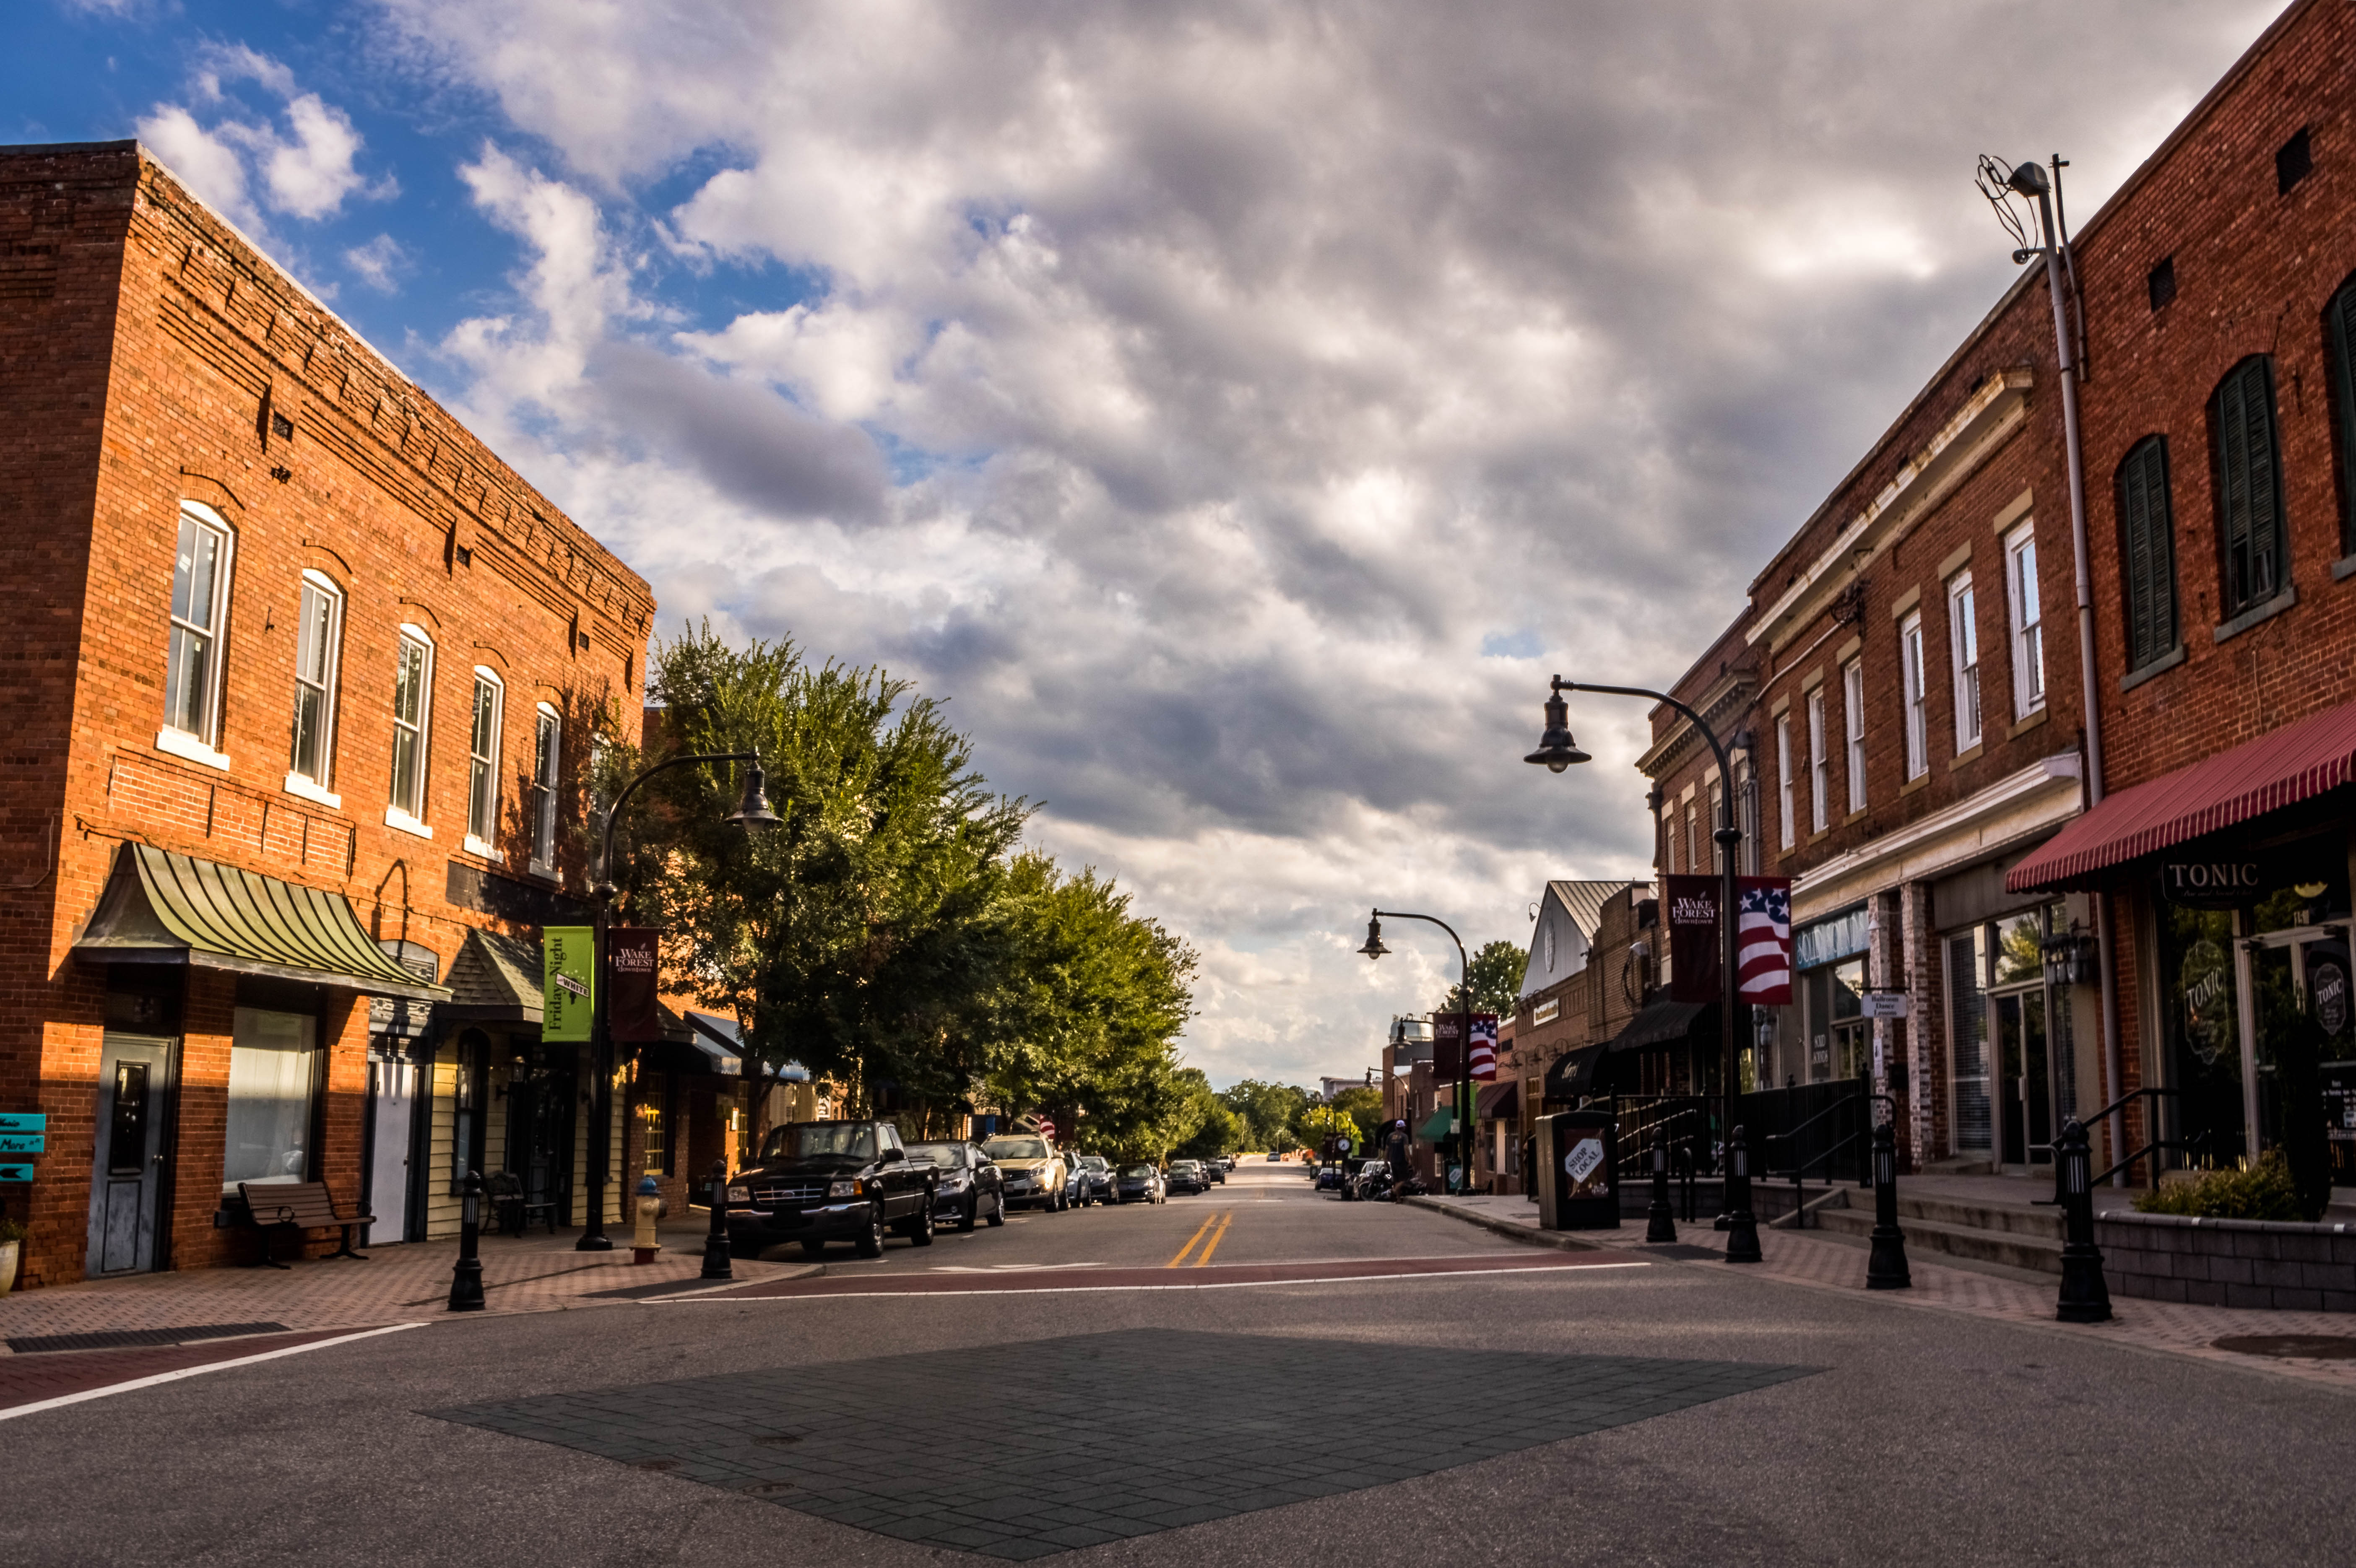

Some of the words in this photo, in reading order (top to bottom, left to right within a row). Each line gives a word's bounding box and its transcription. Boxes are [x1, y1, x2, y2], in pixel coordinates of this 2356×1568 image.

[2168, 863, 2259, 888] TONIC
[1672, 906, 1716, 918] FOREST
[1677, 897, 1712, 909] WAKE
[1675, 916, 1713, 925] downtown
[549, 937, 567, 976] Night
[615, 956, 654, 966] FOREST
[620, 949, 651, 959] WAKE
[618, 964, 651, 973] downtown
[563, 978, 589, 996] WHITE
[2186, 966, 2223, 1015] TONIC
[2317, 978, 2342, 1005] TONIC
[549, 985, 567, 1031] Friday
[0, 1138, 25, 1150] More
[1568, 1147, 1587, 1169] SHOP
[1575, 1151, 1599, 1175] LOCAL
